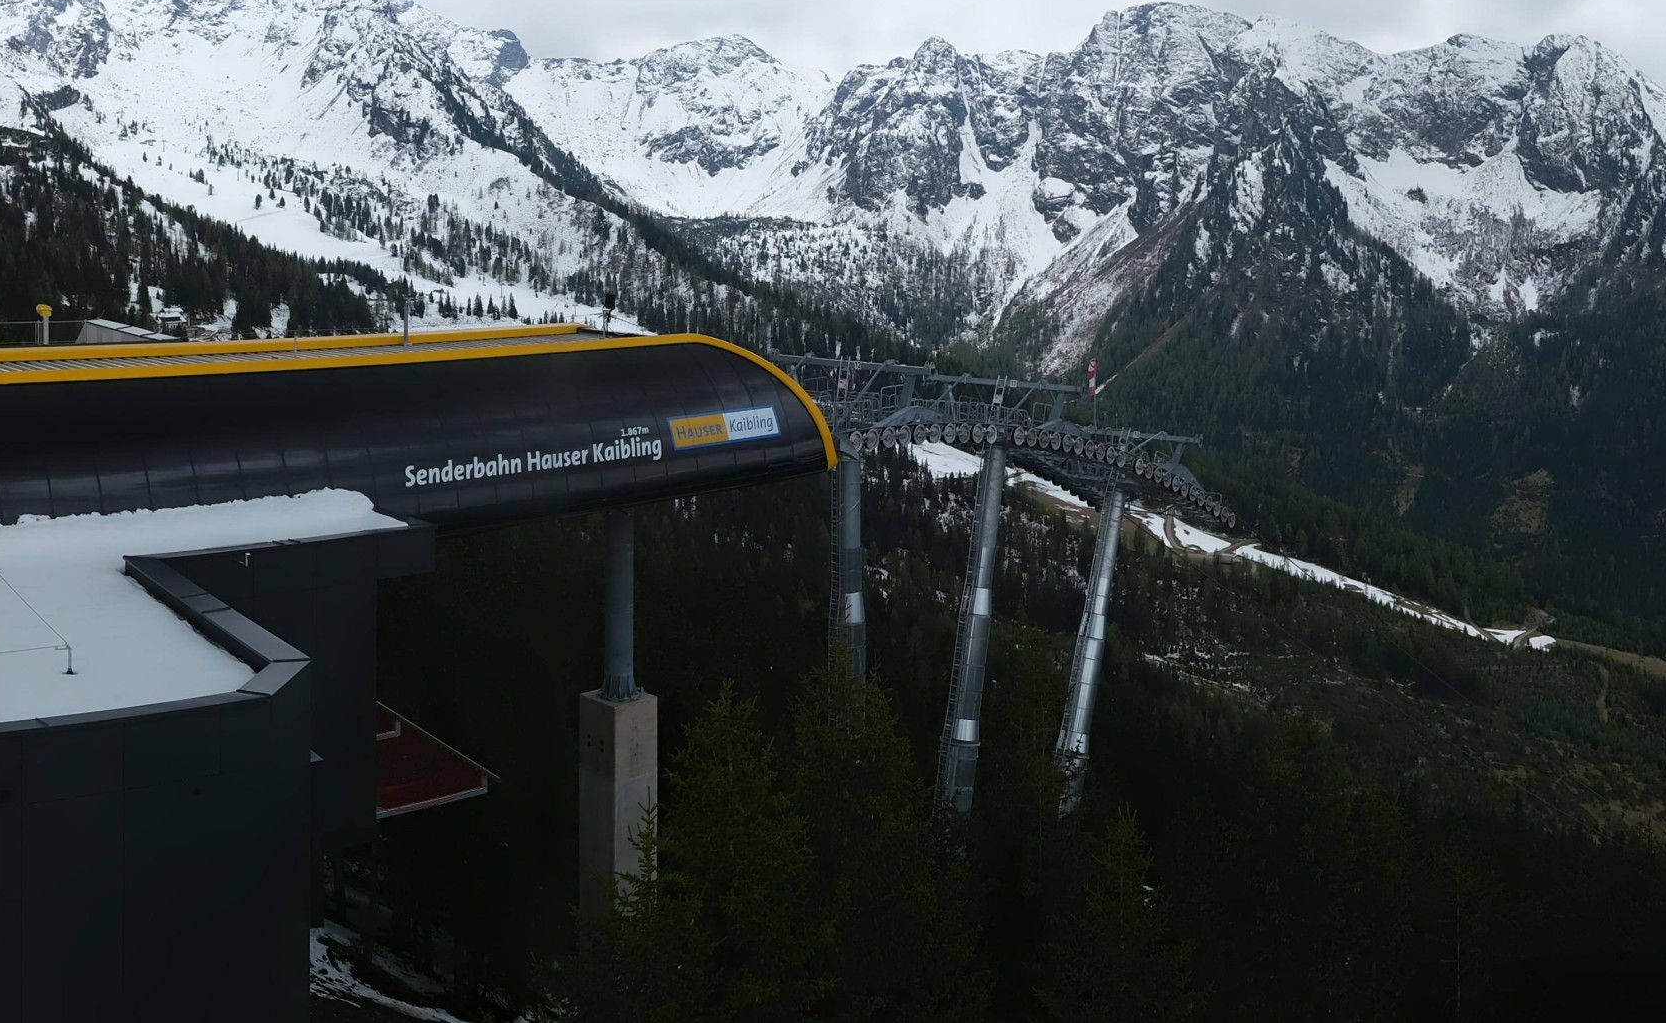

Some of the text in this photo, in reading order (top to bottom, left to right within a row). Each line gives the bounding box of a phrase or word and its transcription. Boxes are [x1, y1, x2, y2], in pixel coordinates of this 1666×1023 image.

[620, 426, 649, 437] 1.867m
[676, 415, 774, 440] HAUSER Kaibling
[404, 437, 662, 487] Senderbahn Hauser Kaibling
